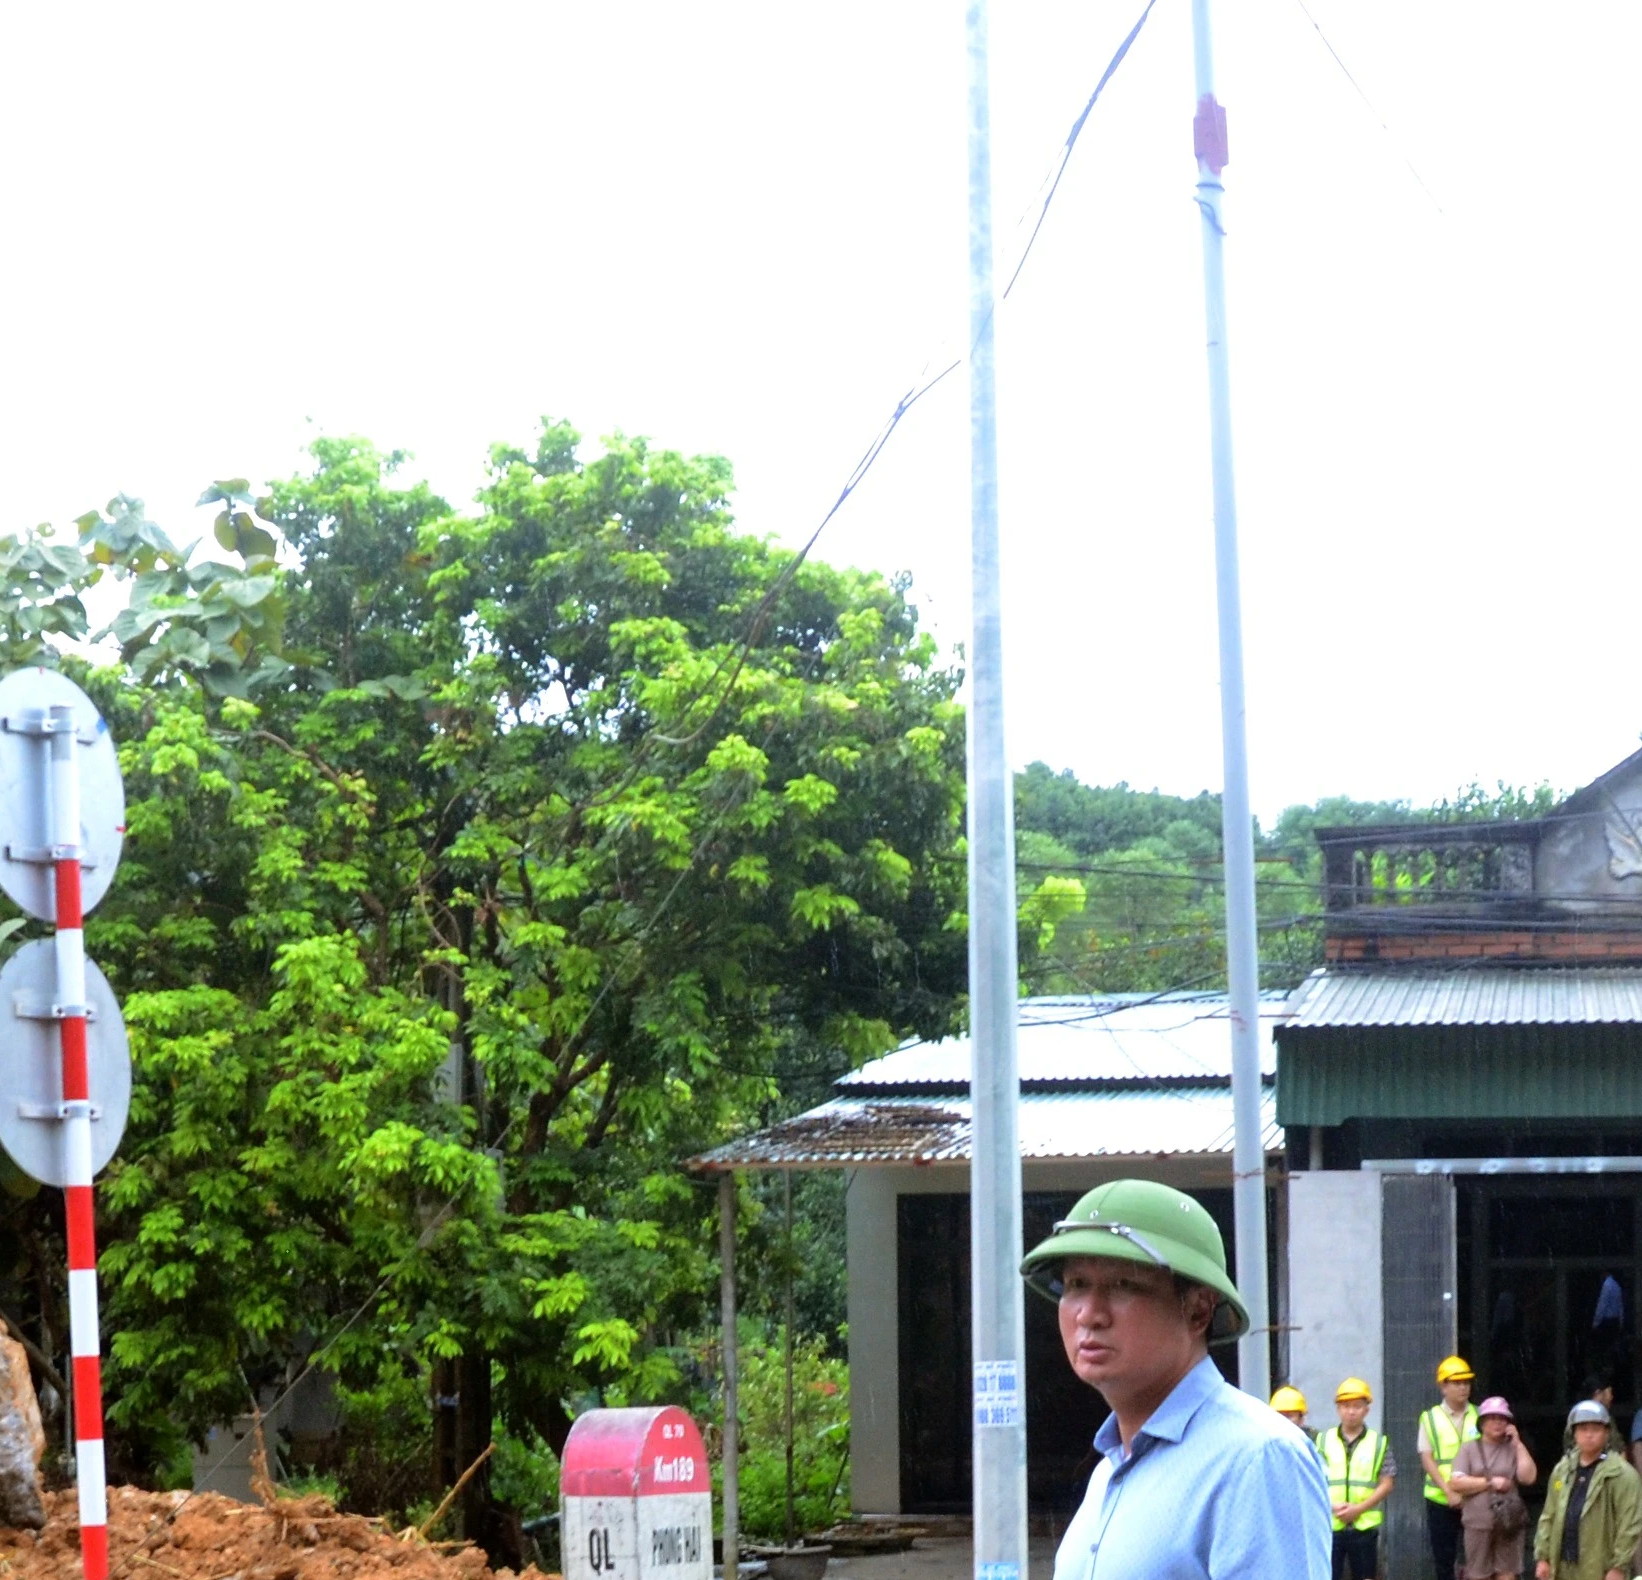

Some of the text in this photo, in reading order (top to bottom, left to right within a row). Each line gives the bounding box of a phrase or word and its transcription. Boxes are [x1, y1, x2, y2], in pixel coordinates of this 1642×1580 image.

[662, 1423, 685, 1439] QL 70
[589, 1527, 615, 1577] QL
[652, 1527, 683, 1567] PHONG
